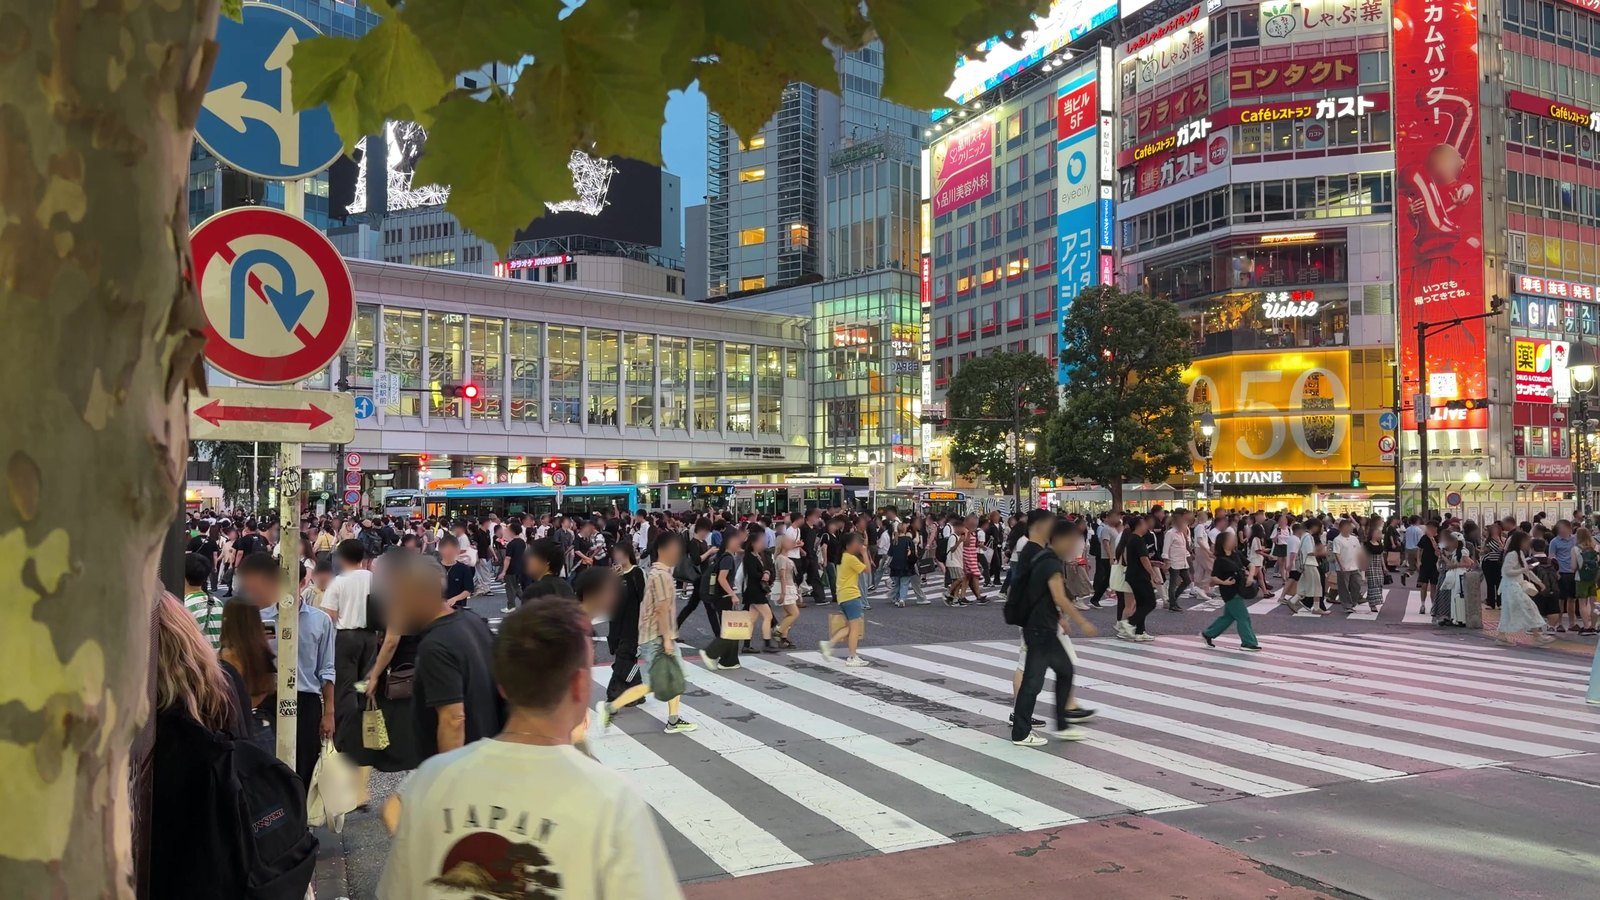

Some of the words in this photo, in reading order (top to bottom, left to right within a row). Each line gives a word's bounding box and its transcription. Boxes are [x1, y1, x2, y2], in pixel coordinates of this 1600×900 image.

[1303, 0, 1383, 29] しゃぶ葉
[1161, 32, 1205, 70] しゃぶ葉
[1123, 69, 1136, 87] 9F
[1231, 59, 1354, 92] コンタクト
[1063, 91, 1090, 117] 当ビル
[1138, 83, 1208, 130] プライス
[1315, 96, 1375, 120] ガスト
[1069, 110, 1084, 130] 5F
[1176, 118, 1213, 148] ガスト
[958, 142, 986, 165] クリニック
[1160, 152, 1203, 187] ガスト
[940, 172, 989, 208] 品川美容外科
[1061, 184, 1092, 204] eyecity
[1414, 289, 1470, 305] 帰ってきてね。
[1423, 281, 1457, 293] いつでも
[1262, 301, 1319, 319] Ushi8
[1511, 300, 1557, 326] AGA
[1518, 344, 1533, 369] 薬
[442, 805, 558, 844] JAPAN
